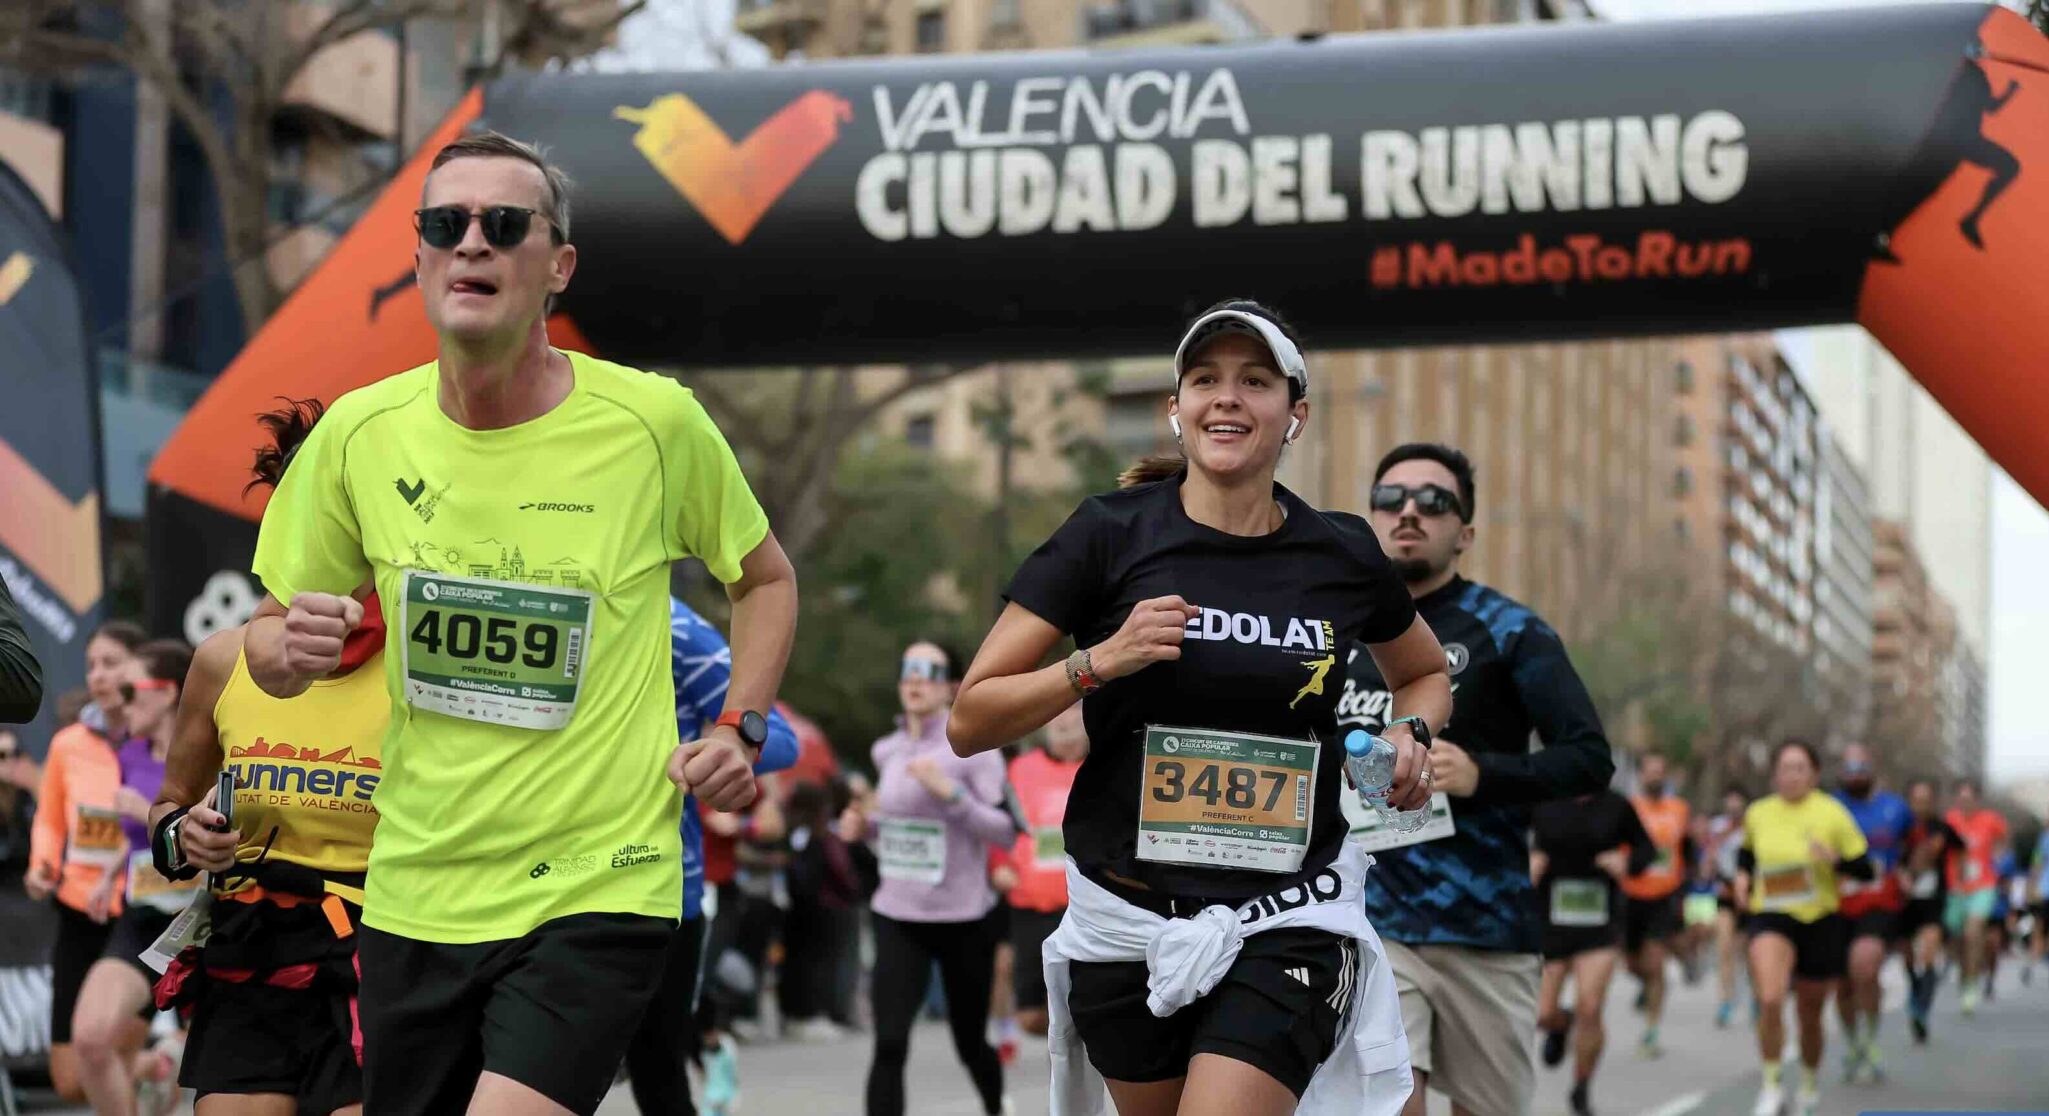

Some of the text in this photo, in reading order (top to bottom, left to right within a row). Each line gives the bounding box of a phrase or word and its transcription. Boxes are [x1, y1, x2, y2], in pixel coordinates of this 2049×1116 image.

[872, 67, 1250, 150] VALENCIA
[855, 109, 1749, 242] CIUDAD DEL RUNNING
[1370, 230, 1752, 289] #MadeToRun
[537, 503, 595, 513] BROOKS
[411, 609, 558, 669] 4059
[1184, 606, 1325, 650] EDOLAT
[1322, 620, 1335, 650] TEAM
[461, 665, 508, 678] PREFERENT
[269, 795, 291, 806] DE
[1152, 761, 1288, 811] 3487
[1190, 824, 1254, 837] #ValènciaCorre
[1202, 811, 1247, 822] PREFERENT
[611, 854, 661, 868] Esfuerzo
